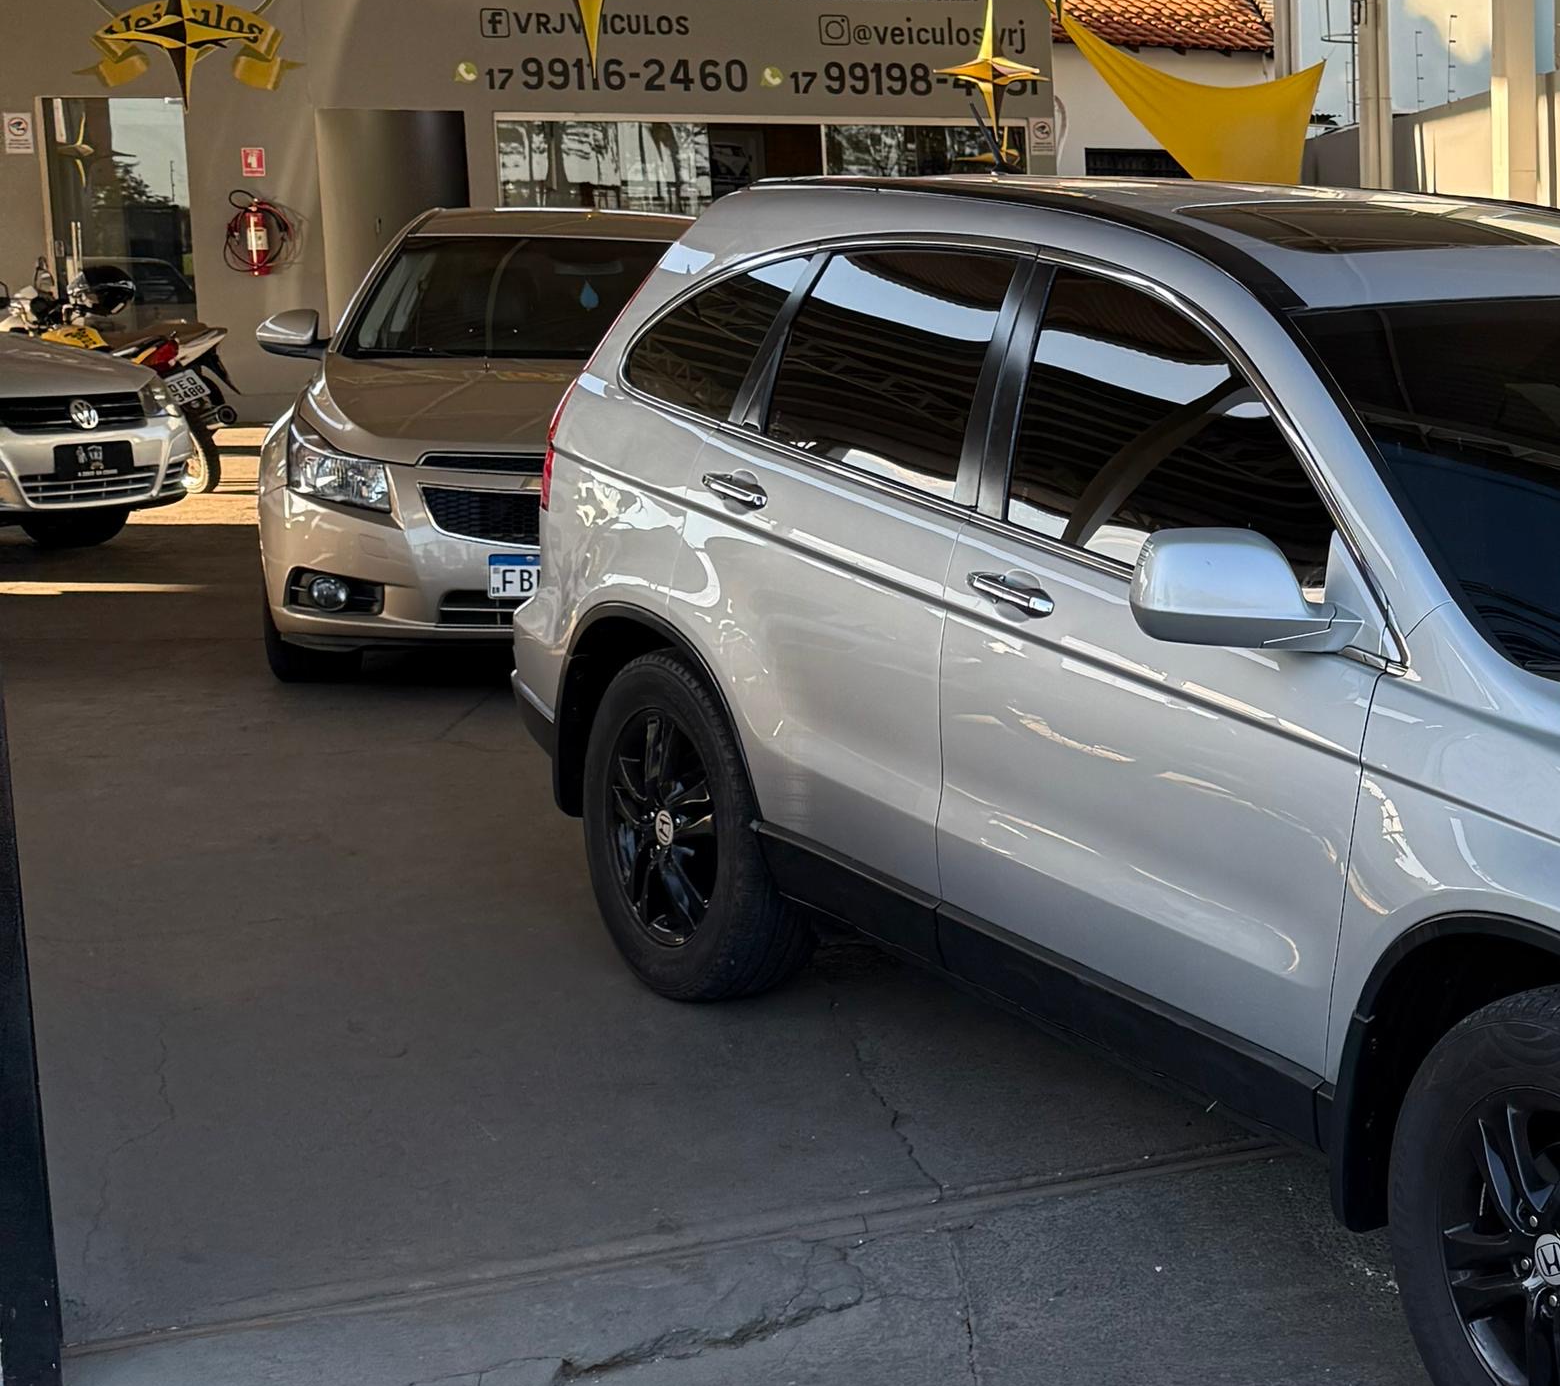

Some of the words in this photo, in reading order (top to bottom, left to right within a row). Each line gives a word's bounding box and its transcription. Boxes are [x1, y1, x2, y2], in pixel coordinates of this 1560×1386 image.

[103, 3, 264, 43] Veíulos
[513, 12, 690, 36] VRJVICULOS
[485, 68, 514, 90] 17
[789, 71, 818, 94] 17
